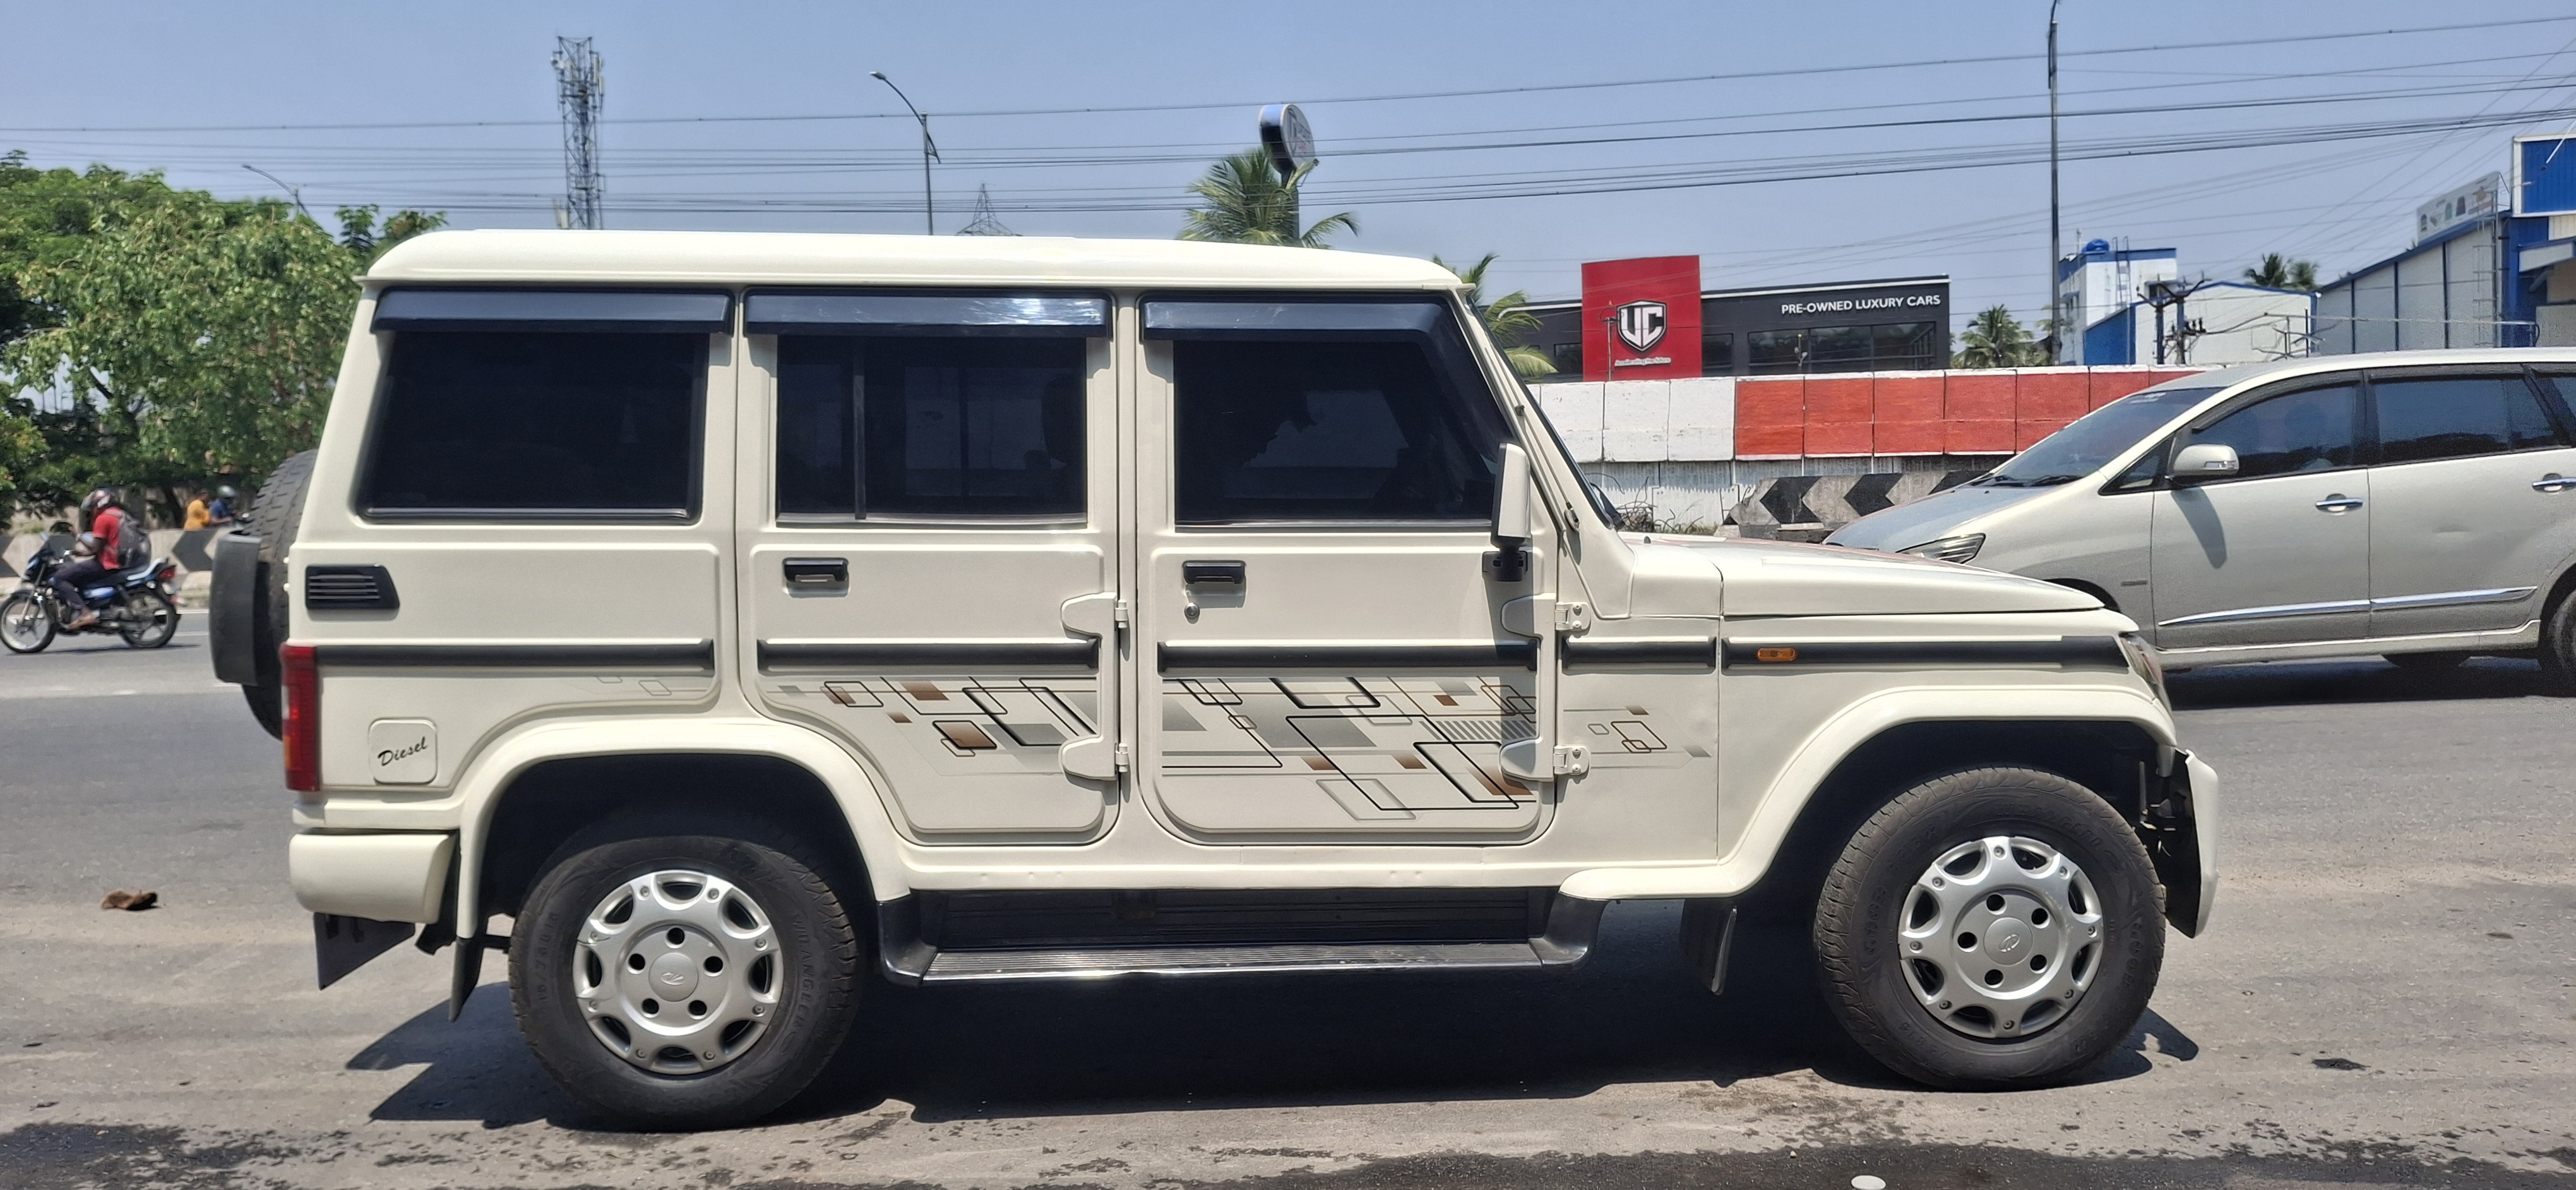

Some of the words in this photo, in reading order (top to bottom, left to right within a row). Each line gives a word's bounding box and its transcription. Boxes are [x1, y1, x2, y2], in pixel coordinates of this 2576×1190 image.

[1782, 300, 1853, 315] PRE-OWNED
[1856, 296, 1904, 310] LUXURY
[1907, 294, 1941, 307] CARS
[1620, 306, 1663, 348] UC
[378, 736, 428, 766] Diesel
